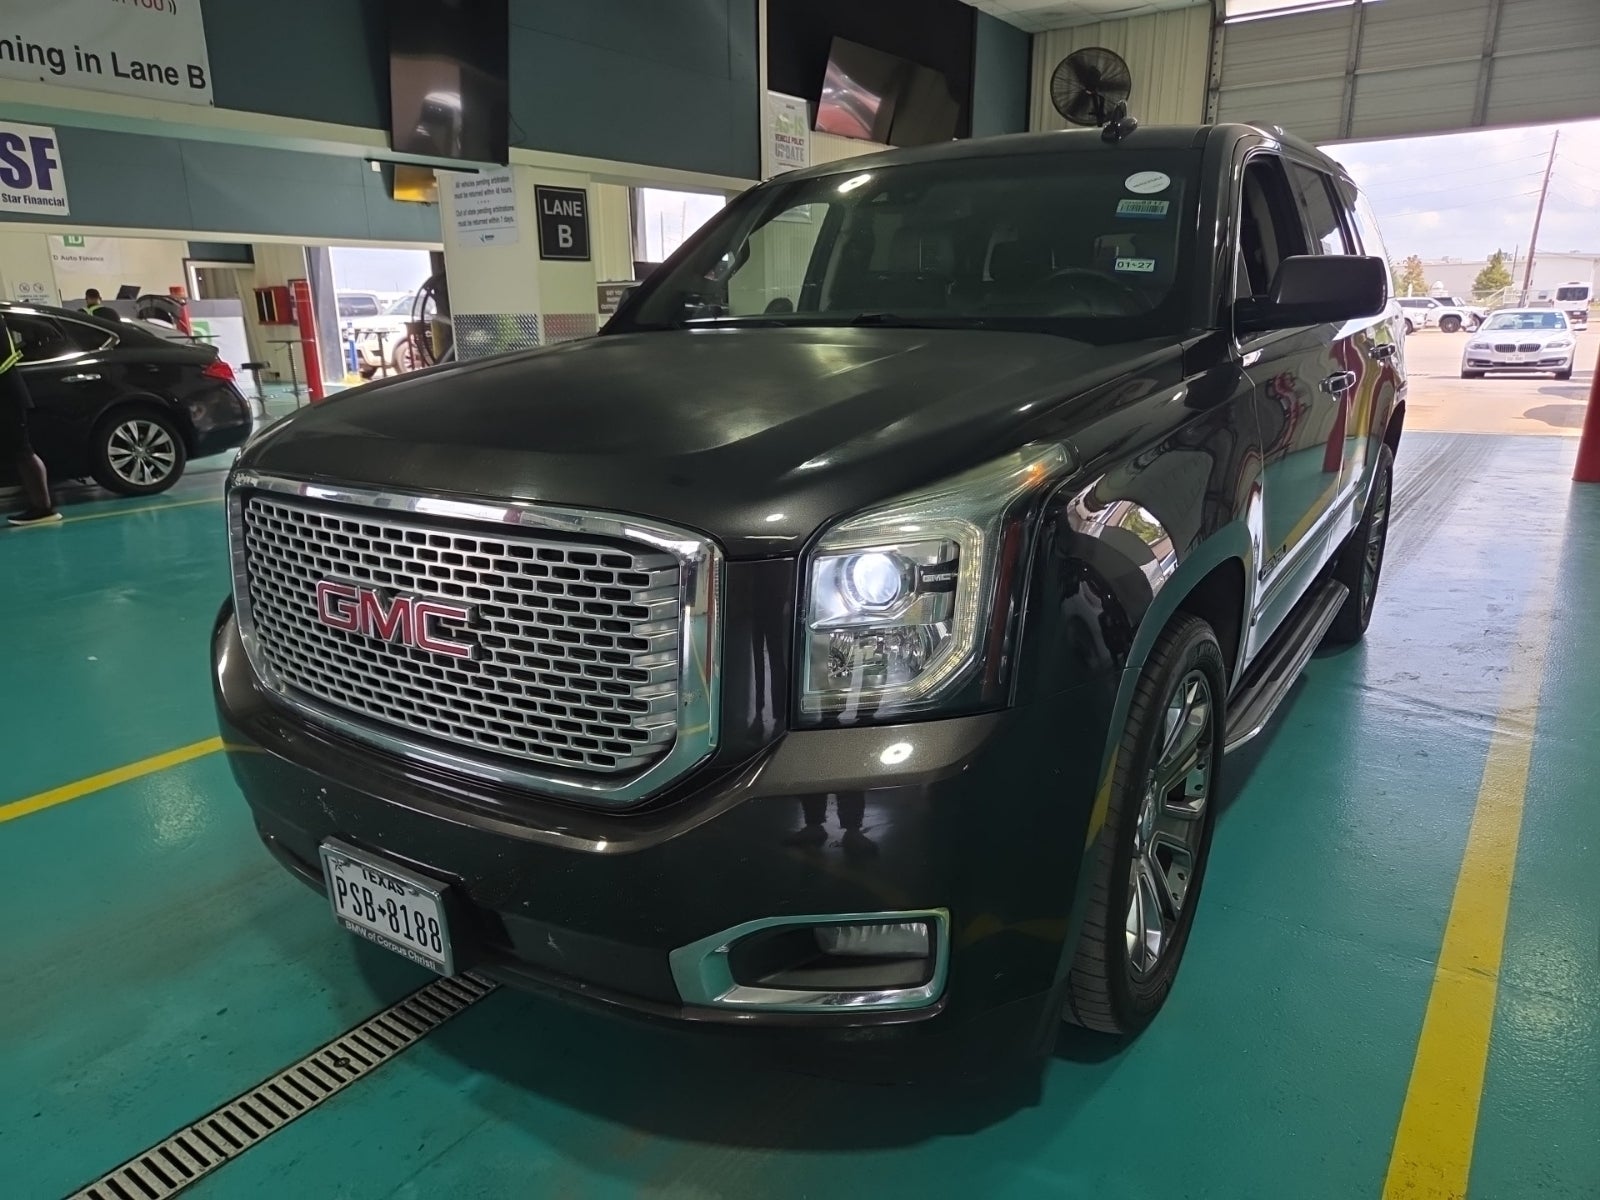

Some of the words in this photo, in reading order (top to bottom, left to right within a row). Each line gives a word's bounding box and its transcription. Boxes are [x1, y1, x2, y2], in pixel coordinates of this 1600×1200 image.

[74, 45, 102, 74] in
[110, 51, 180, 86] Lane
[186, 63, 207, 89] B
[0, 132, 58, 191] SF
[775, 142, 804, 162] UPDATE
[1, 193, 21, 204] Star
[23, 195, 66, 207] Financial
[543, 198, 583, 217] LANE
[558, 224, 573, 249] B
[923, 573, 951, 582] GMC
[316, 578, 475, 659] GMC
[361, 867, 406, 897] TEXAS
[345, 920, 367, 937] BMW
[367, 932, 376, 942] of
[377, 935, 408, 956] Corpus
[407, 950, 436, 970] Christi
